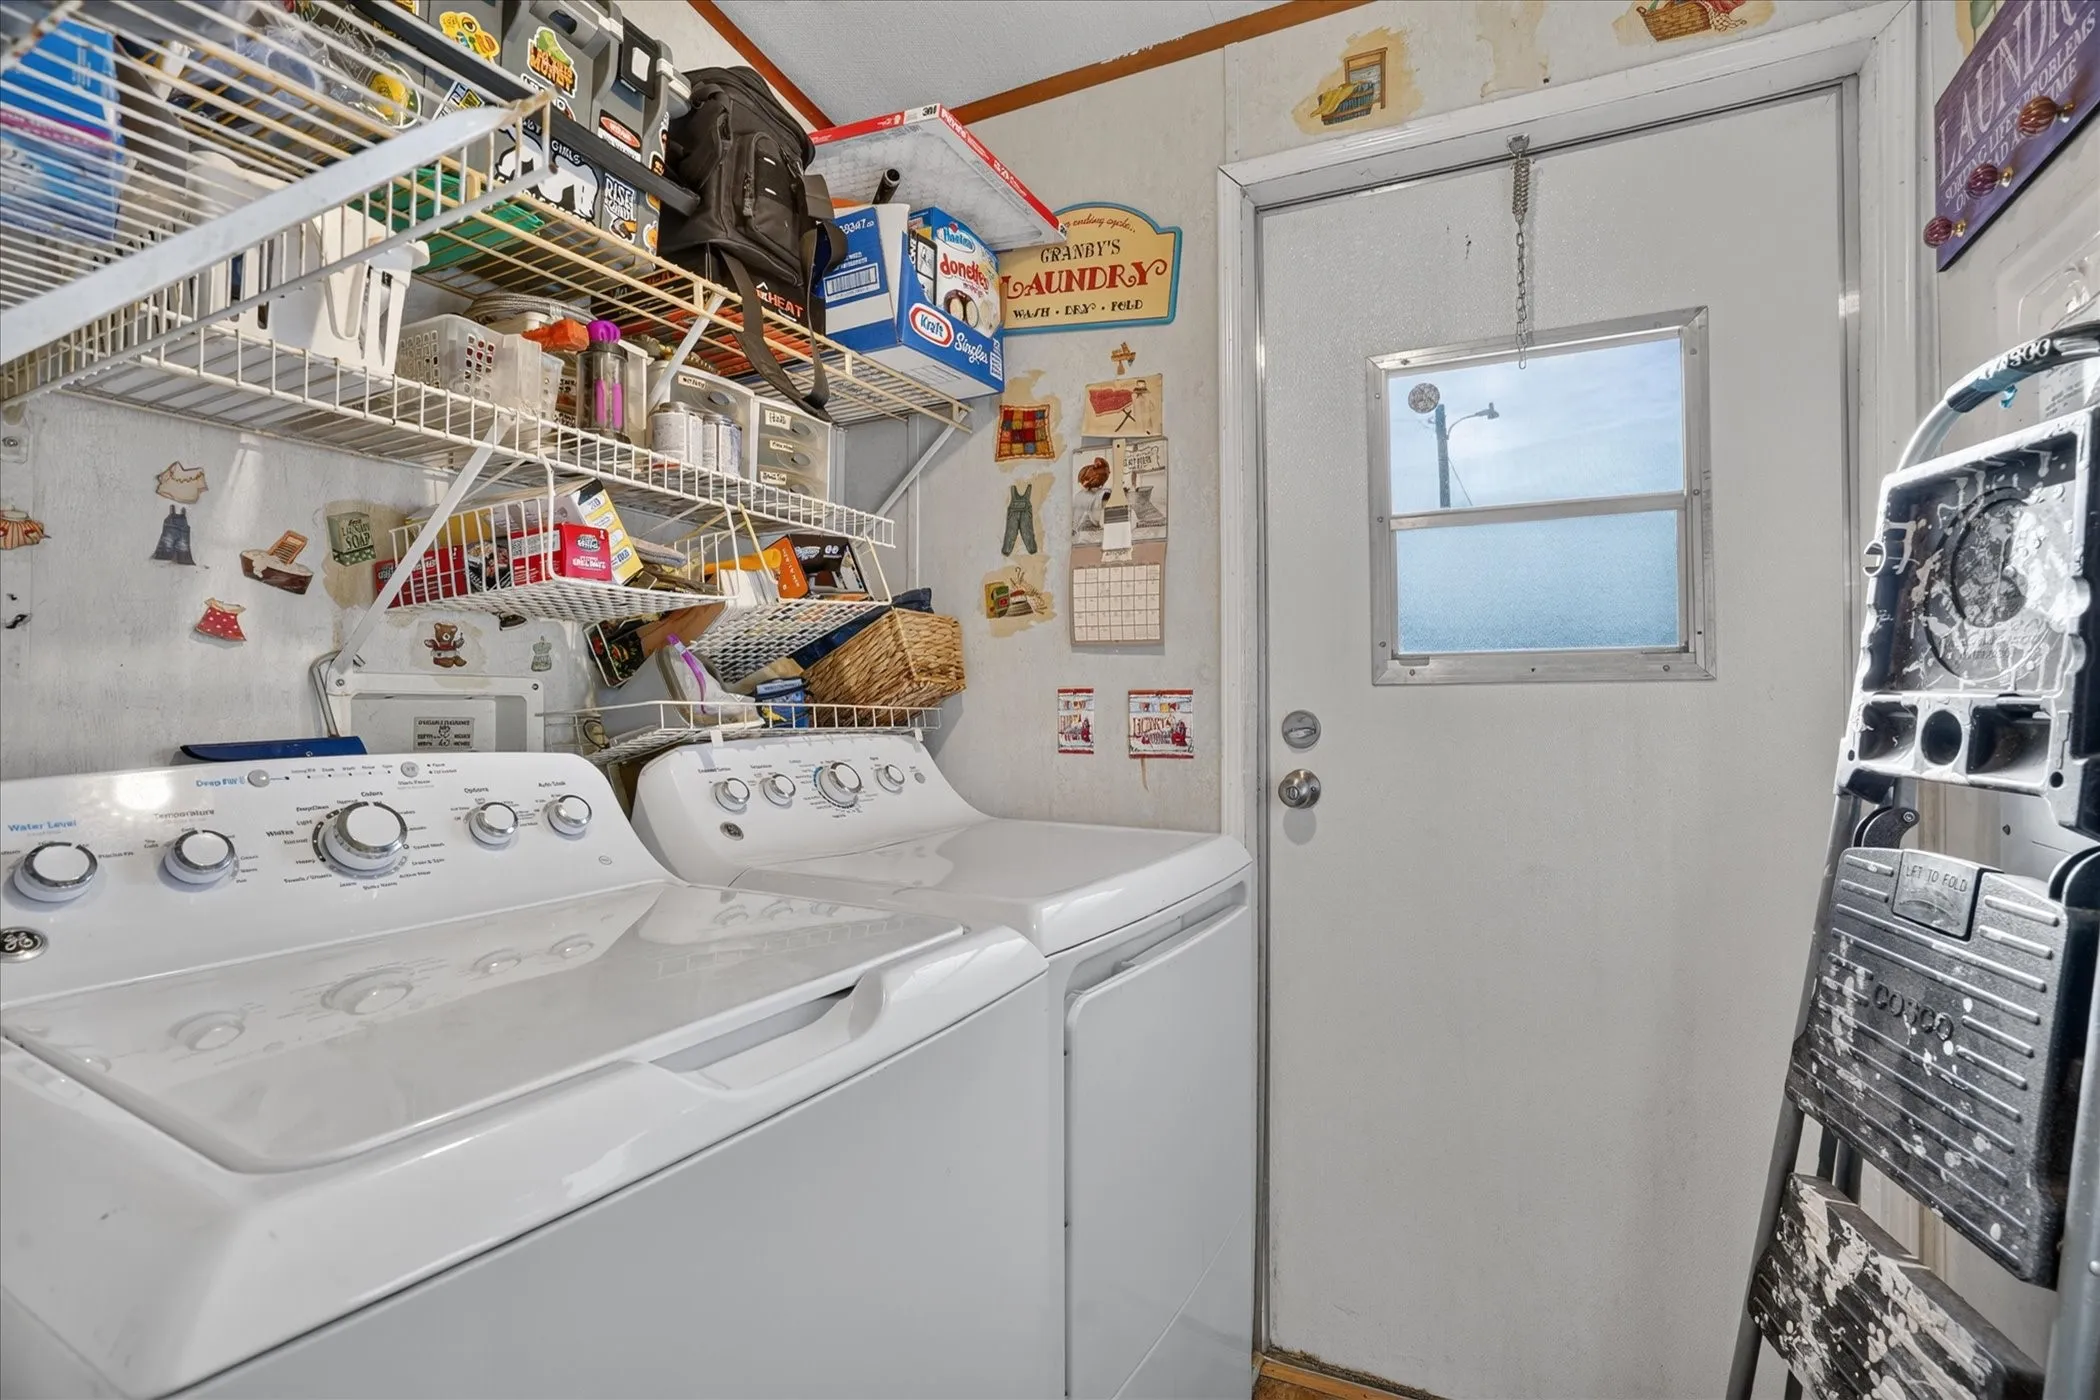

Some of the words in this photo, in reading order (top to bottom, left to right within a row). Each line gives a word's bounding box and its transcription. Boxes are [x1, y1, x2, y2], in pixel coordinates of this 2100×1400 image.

[605, 178, 636, 208] RISE
[1041, 238, 1121, 264] GRANBY'S
[1000, 258, 1168, 299] LAUNDRY
[1013, 307, 1050, 320] WASH
[1065, 302, 1097, 316] DRY
[1111, 299, 1143, 312] FOLD
[920, 314, 945, 339] Kraft
[954, 332, 989, 365] Singles
[345, 532, 371, 550] SOAP
[8, 823, 44, 832] Water
[47, 819, 77, 829] Level
[154, 809, 215, 820] Temperature
[1926, 869, 1940, 882] TO
[1941, 873, 1968, 892] FOLD
[1874, 983, 1955, 1042] COSCO
